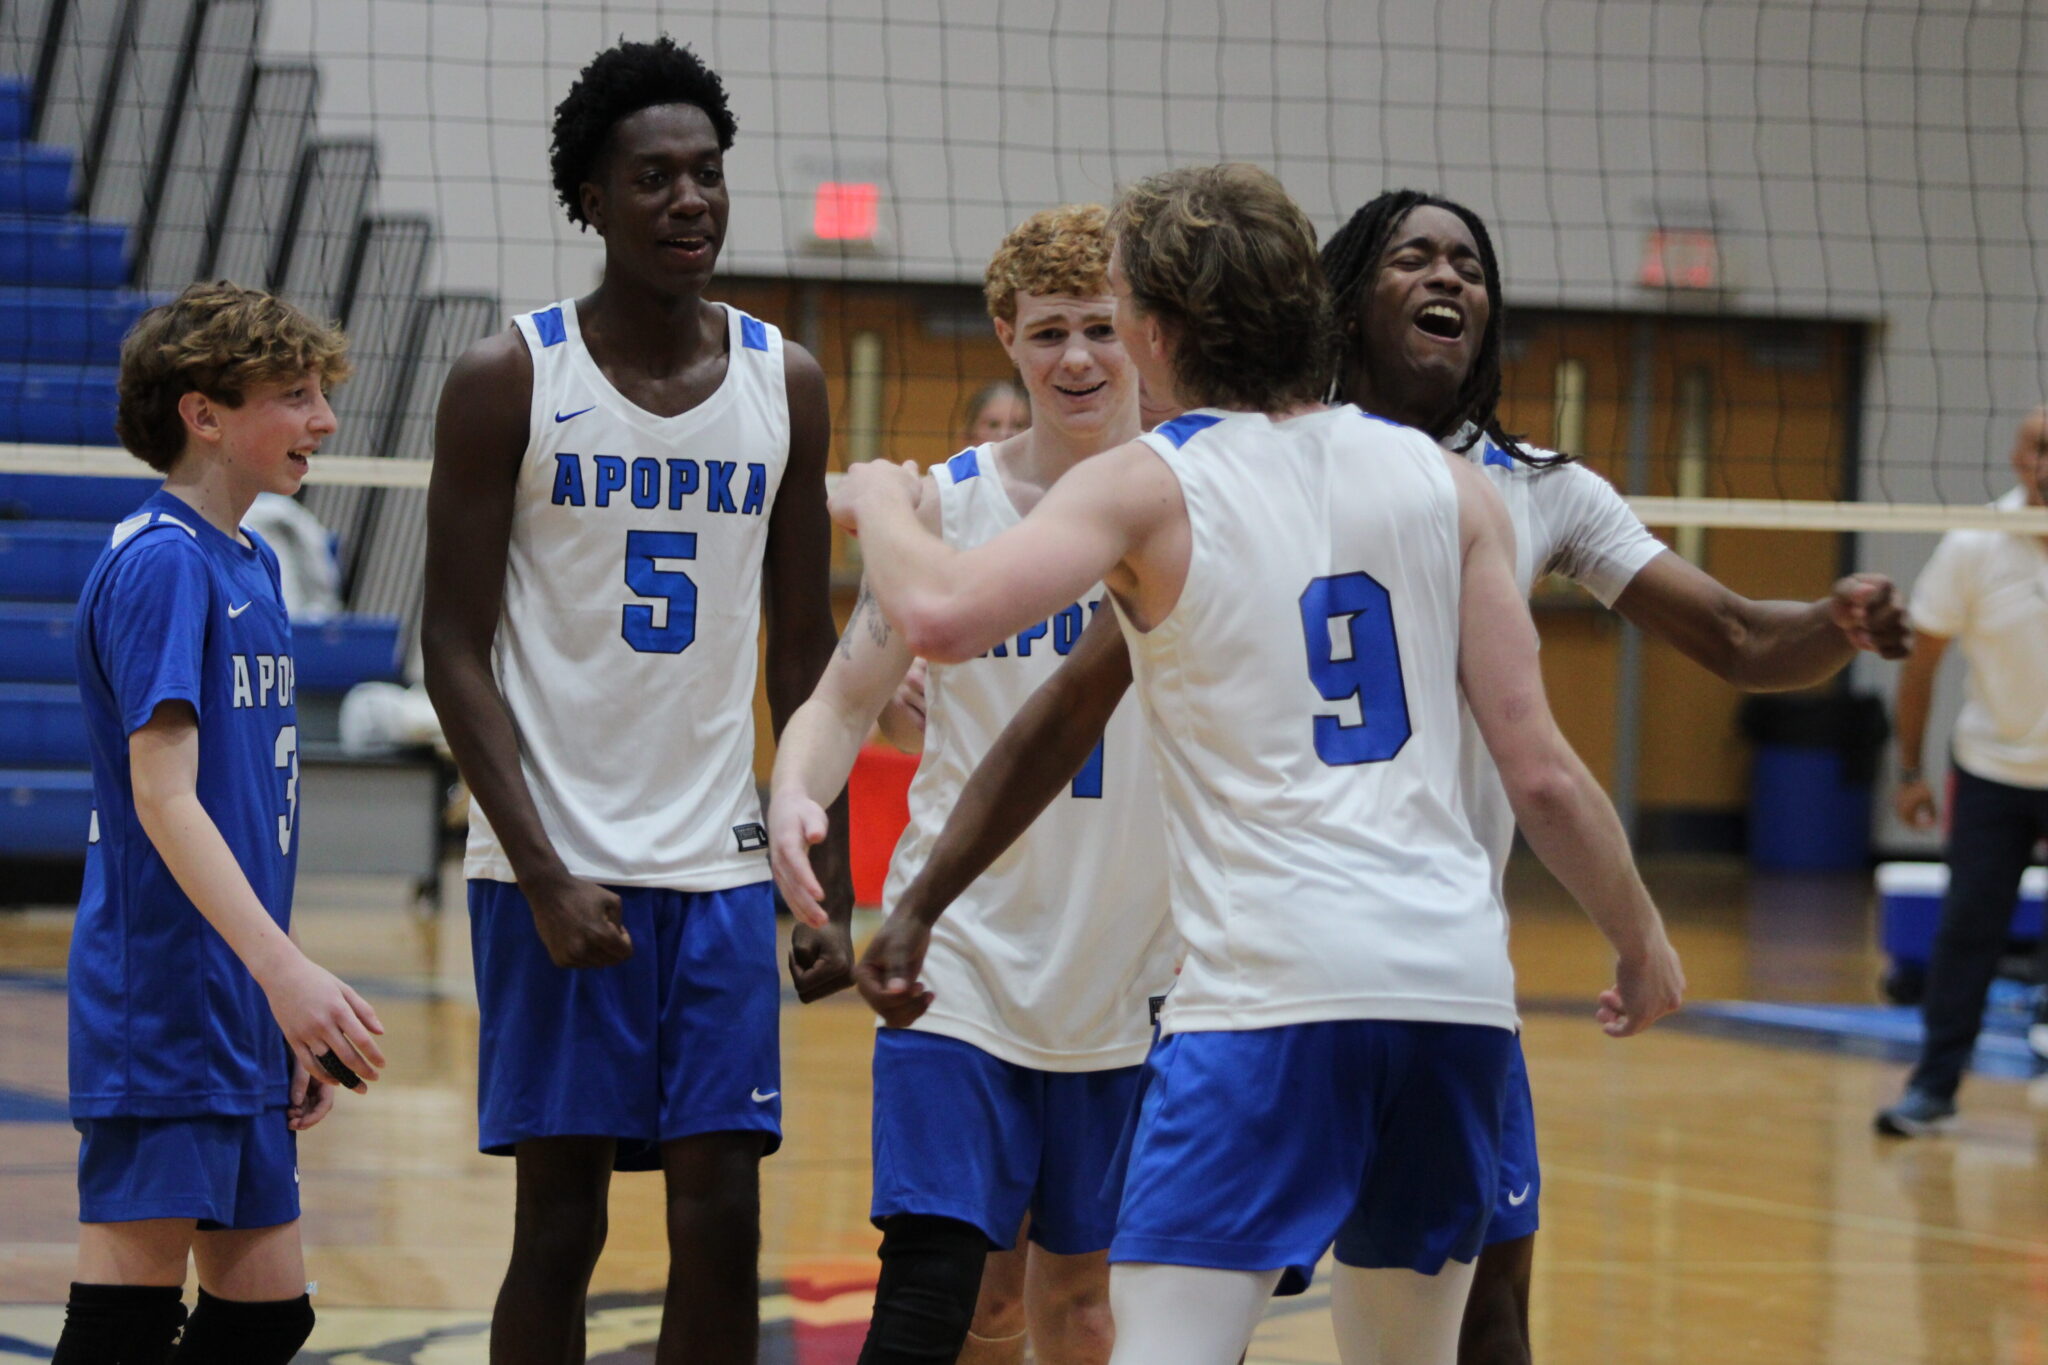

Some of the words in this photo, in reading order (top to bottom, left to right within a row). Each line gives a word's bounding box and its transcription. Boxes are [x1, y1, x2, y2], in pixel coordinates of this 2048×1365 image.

[551, 453, 767, 515] APOPKA
[621, 530, 698, 655] 5
[976, 600, 1101, 658] PO
[1298, 570, 1412, 767] 9
[274, 725, 299, 857] 3
